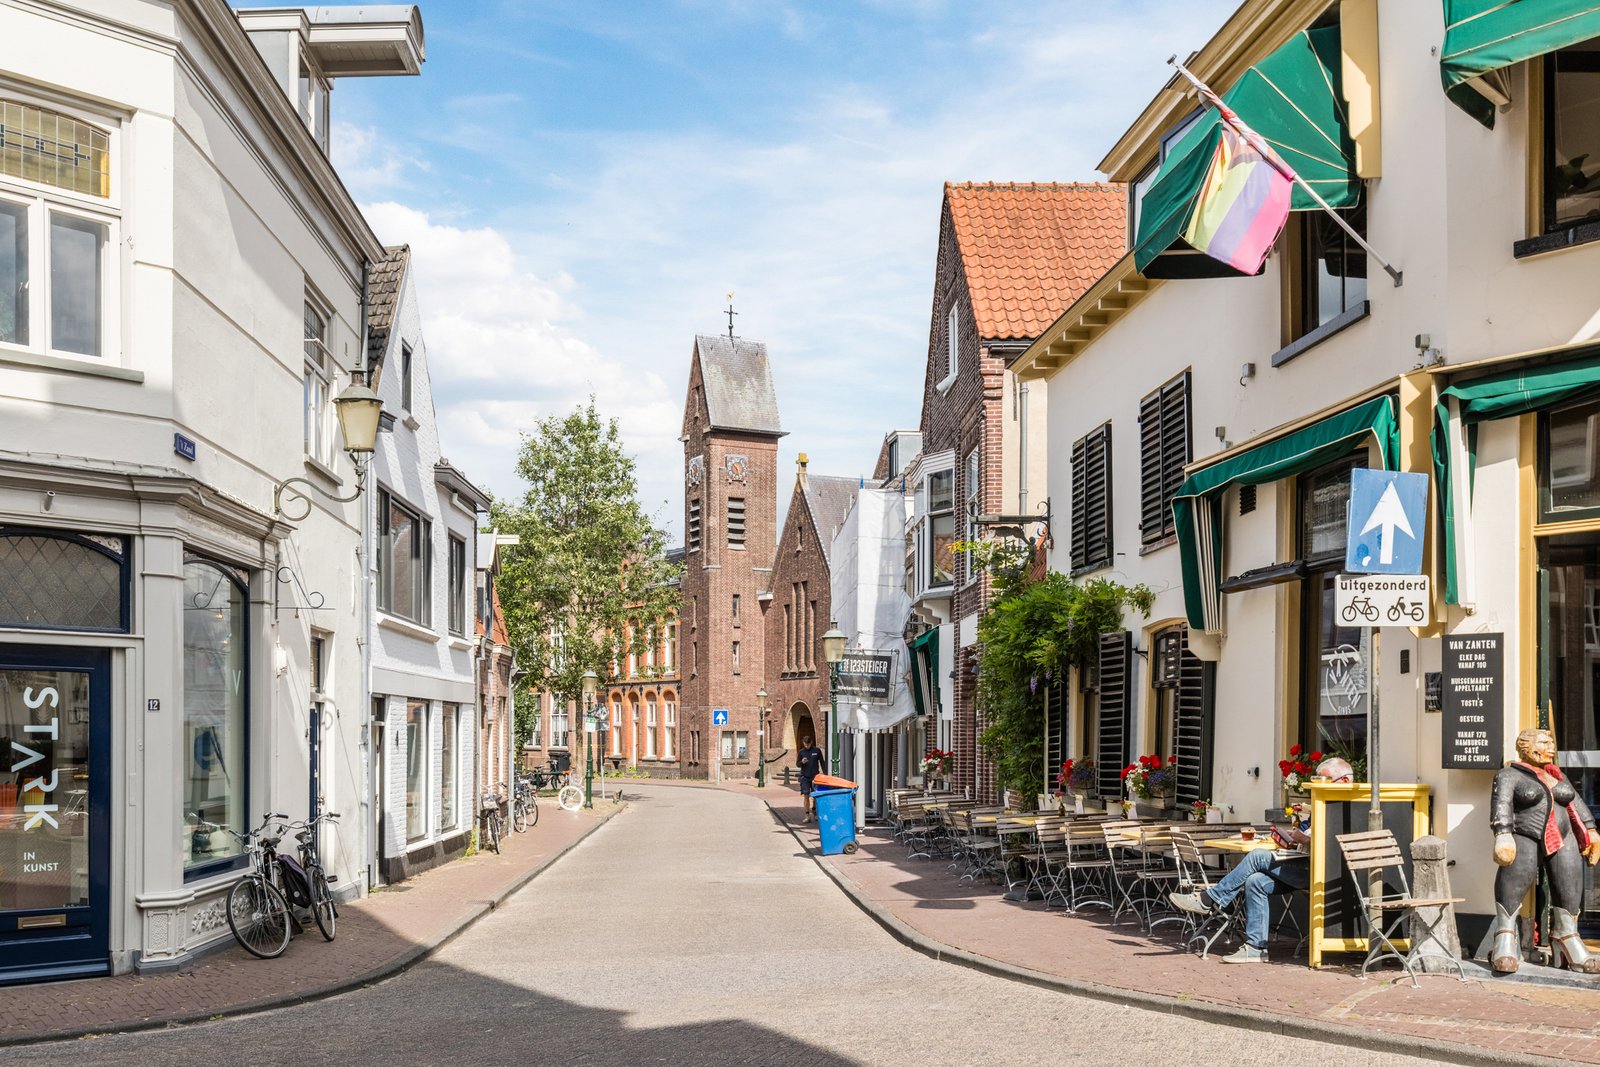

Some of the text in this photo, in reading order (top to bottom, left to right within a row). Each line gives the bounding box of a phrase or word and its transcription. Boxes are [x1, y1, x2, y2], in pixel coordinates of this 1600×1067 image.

[1341, 580, 1426, 593] uitgezonderd
[1449, 640, 1496, 650] VAN ZANTEN
[1474, 653, 1485, 661] DAG
[1458, 661, 1475, 669] VANAF
[1450, 677, 1494, 685] HUISGEMAAKTE
[1454, 684, 1490, 692] APPELTAART
[149, 700, 158, 710] 12
[1459, 715, 1485, 723] OESTERS
[1457, 731, 1475, 739] VANAF
[1455, 739, 1489, 747] HAMBURGER
[1464, 746, 1479, 754] SATÉ
[11, 686, 59, 832] STARK
[1453, 754, 1467, 762] FISH
[1473, 754, 1490, 762] CHIPS
[24, 852, 35, 860] IN
[24, 862, 59, 872] KUNST
